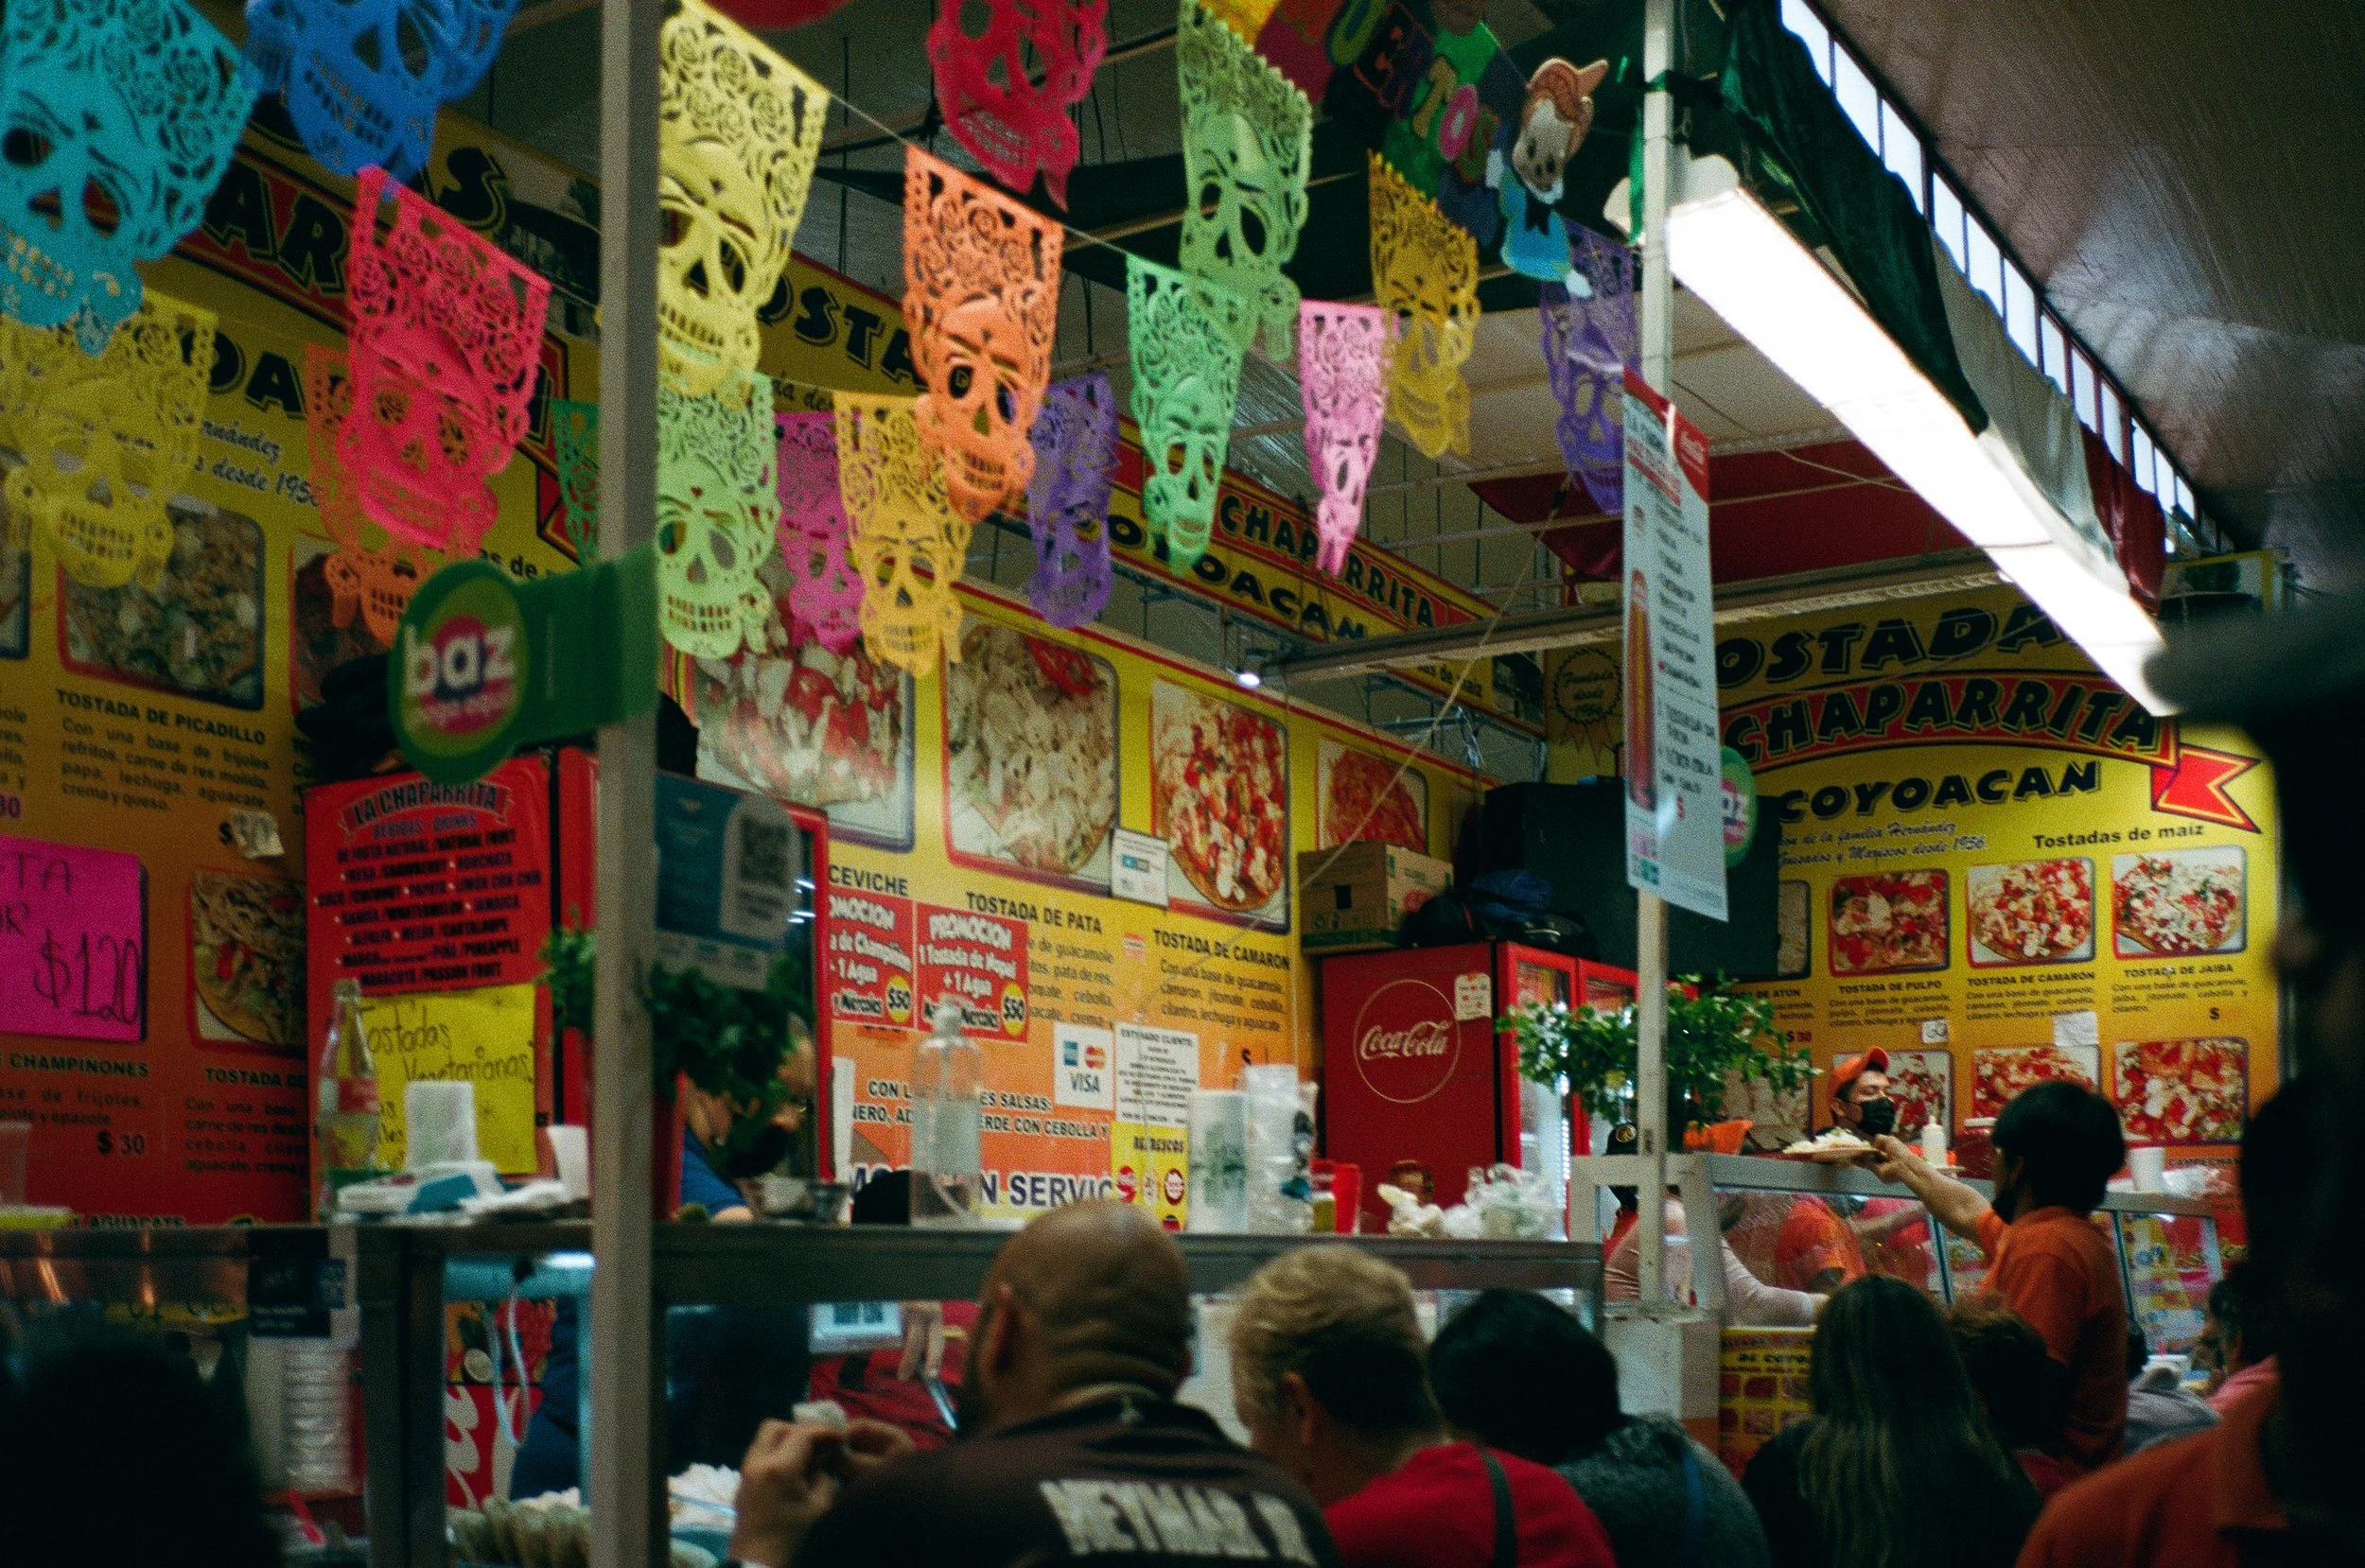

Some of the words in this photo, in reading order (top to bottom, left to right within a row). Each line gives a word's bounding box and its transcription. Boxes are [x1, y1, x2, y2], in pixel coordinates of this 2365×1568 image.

[510, 556, 538, 580] de
[1219, 494, 1435, 628] CHAPRRITA
[404, 623, 516, 698] baz
[55, 688, 140, 720] TOSTADA
[146, 707, 168, 726] DE
[175, 713, 266, 745] PICADILLO
[1724, 679, 2164, 764] CHAPARRITA
[61, 716, 94, 736] Con
[106, 728, 133, 744] una
[146, 734, 181, 753] base
[193, 743, 211, 758] de
[125, 753, 166, 769] carne
[170, 760, 187, 775] de
[192, 764, 215, 779] res
[61, 783, 109, 802] crema
[111, 791, 119, 807] y
[1778, 761, 2101, 824] COYOACAN
[352, 801, 377, 826] LA
[218, 821, 234, 845] $
[2033, 829, 2122, 851] Tostadas
[2128, 826, 2151, 844] de
[829, 864, 909, 897] CEVICHE
[966, 891, 1039, 922] TOSTADA
[1043, 907, 1063, 928] DE
[1067, 912, 1103, 934] PATA
[1153, 928, 1211, 956] TOSTADA
[1215, 940, 1230, 958] DE
[1967, 976, 2017, 986] TOSTADA
[2020, 974, 2035, 984] DE
[2124, 967, 2176, 978] TOSTADA
[2180, 966, 2195, 975] DE
[2199, 964, 2234, 974] JAIBA
[1838, 983, 1886, 994] TOSTADA
[1889, 983, 1902, 991] DE
[1905, 981, 1942, 991] PULPO
[9, 1051, 149, 1078] CHAMPIÑONES
[204, 1067, 282, 1087] TOSTADA
[867, 1080, 903, 1100] CON
[1071, 1072, 1101, 1095] VISA
[1015, 1116, 1042, 1135] CON
[1043, 1121, 1097, 1139] CEBOLLA
[1098, 1124, 1109, 1140] Y
[96, 1129, 114, 1157] $
[119, 1134, 146, 1156] 30
